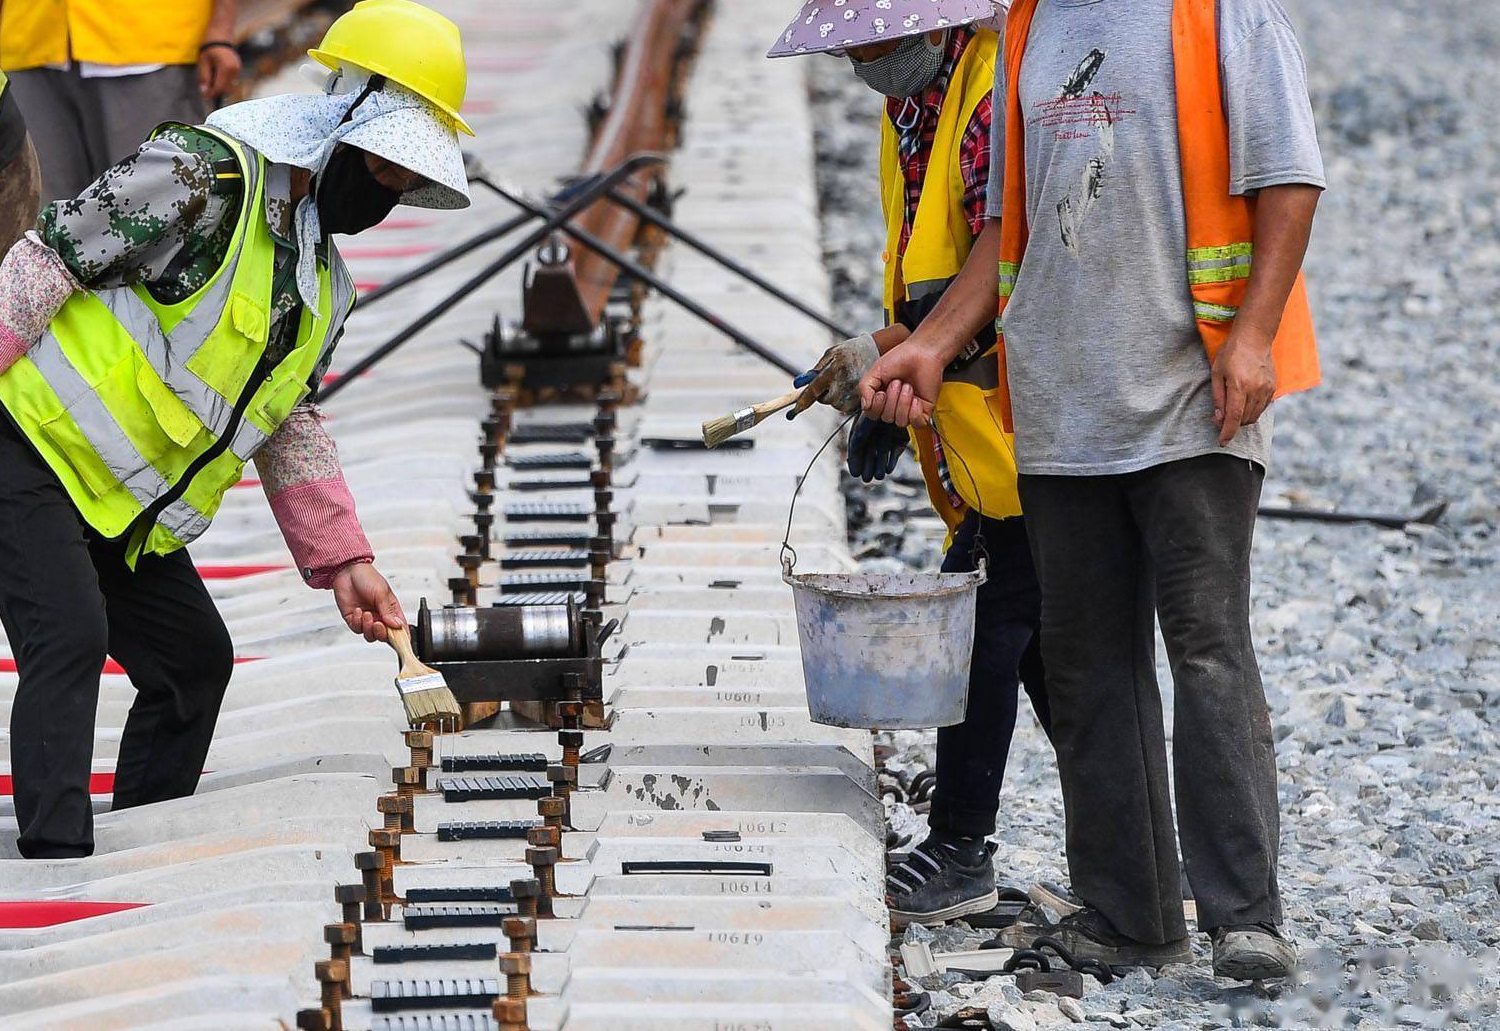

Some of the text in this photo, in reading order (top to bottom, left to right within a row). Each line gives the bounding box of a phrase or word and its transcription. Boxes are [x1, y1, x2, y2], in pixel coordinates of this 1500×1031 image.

[739, 821, 787, 833] 10612
[720, 881, 772, 893] 10614
[708, 932, 763, 945] 10619
